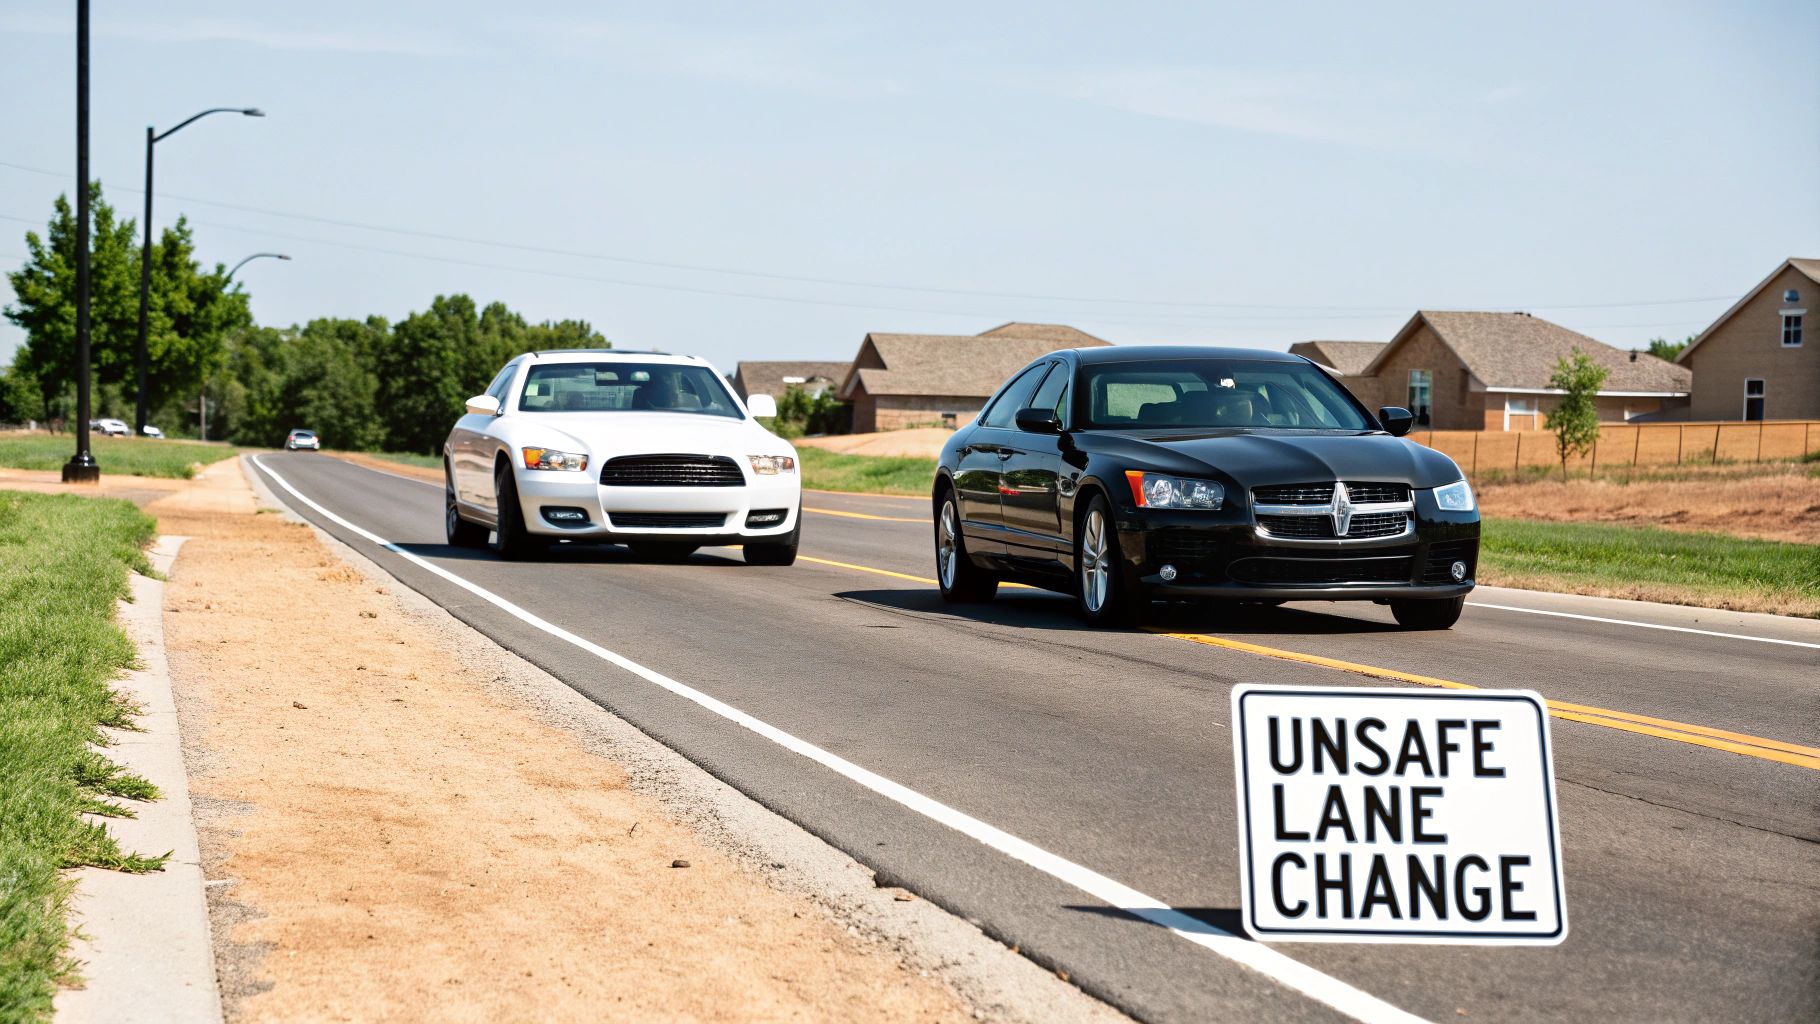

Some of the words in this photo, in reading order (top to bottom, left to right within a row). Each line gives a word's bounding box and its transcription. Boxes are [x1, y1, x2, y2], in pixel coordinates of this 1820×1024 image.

[1268, 717, 1506, 778] UNSAFE
[1272, 784, 1448, 844] LANE
[1271, 852, 1538, 921] CHANGE
